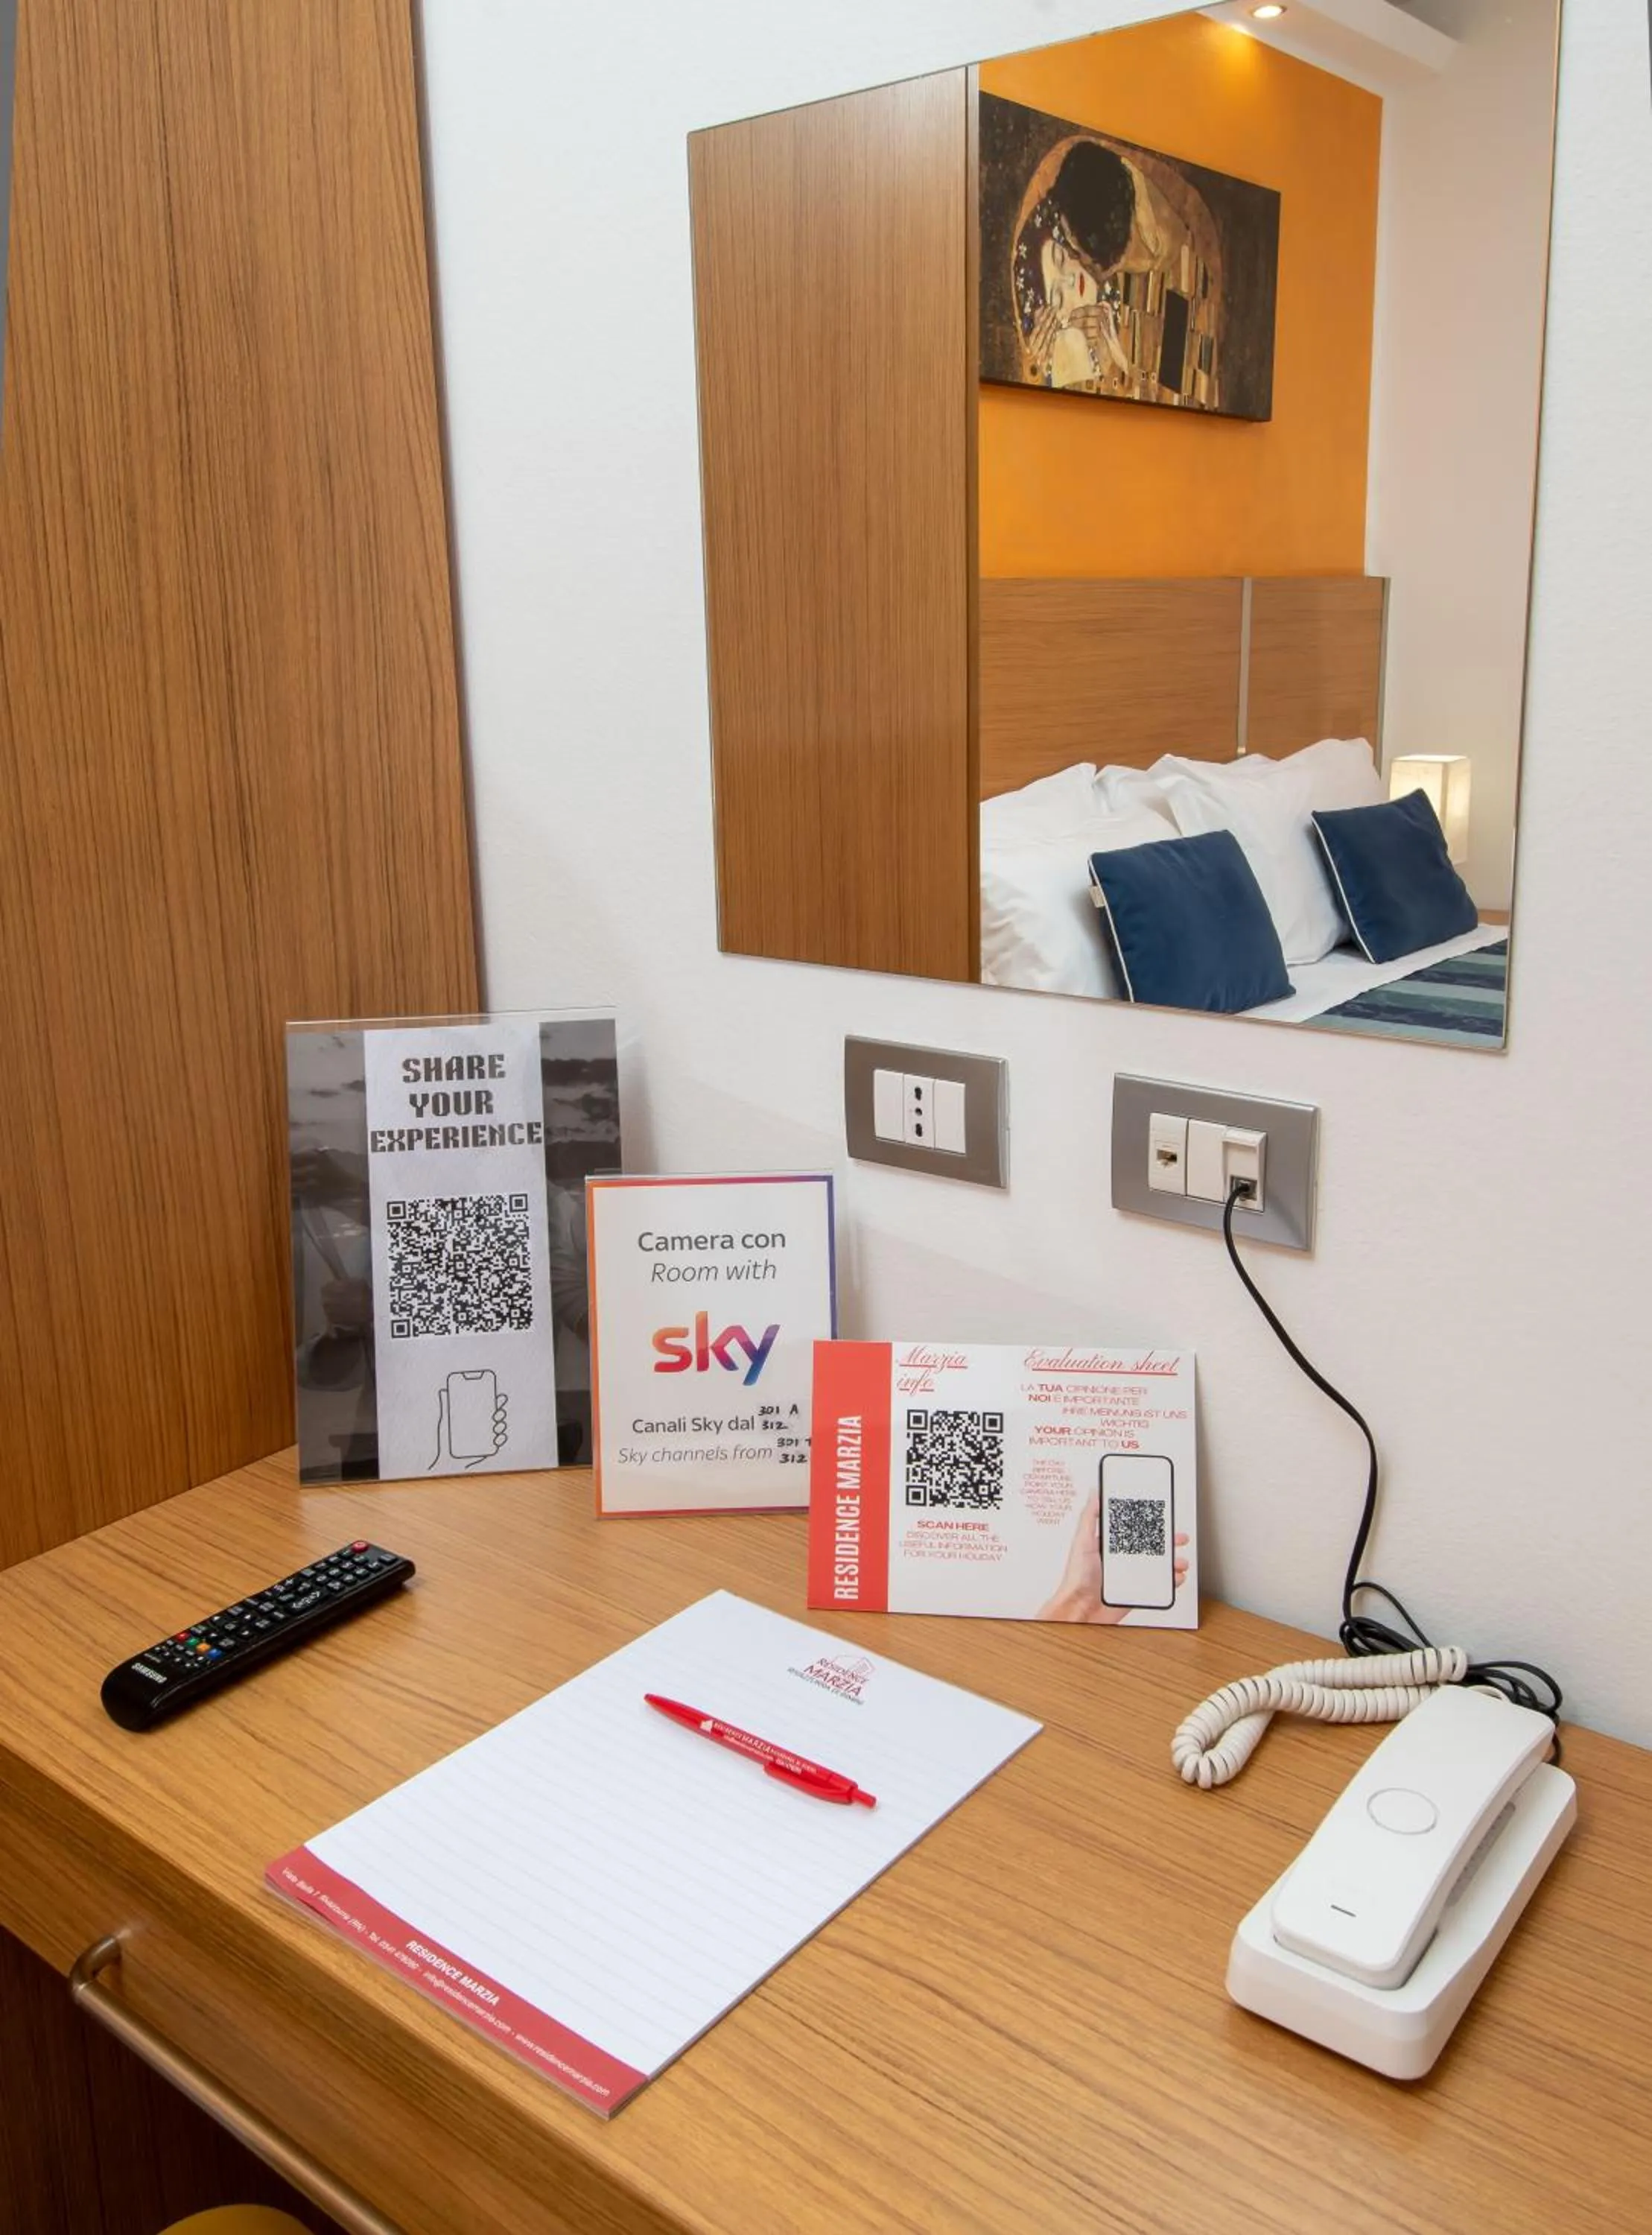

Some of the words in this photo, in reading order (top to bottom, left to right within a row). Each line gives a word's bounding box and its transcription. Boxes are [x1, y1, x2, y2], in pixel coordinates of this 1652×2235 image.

[402, 1053, 506, 1082] SHARE
[409, 1090, 494, 1118] YOUR
[370, 1121, 544, 1153] EXPERIENCE
[638, 1231, 734, 1252] Camera
[740, 1232, 787, 1249] con
[651, 1262, 719, 1283] Room
[725, 1258, 777, 1281] with
[652, 1310, 781, 1386] sky
[899, 1345, 967, 1374] Marzia
[1024, 1348, 1123, 1370] Evaluation
[1131, 1350, 1181, 1372] sheet
[1028, 1394, 1052, 1403] NOI
[1038, 1383, 1064, 1393] TUA
[758, 1405, 780, 1416] 301
[632, 1416, 687, 1434] Canali
[692, 1416, 724, 1436] Sky
[728, 1415, 754, 1431] dal
[1034, 1425, 1071, 1436] YOUR
[618, 1448, 647, 1466] Sky
[651, 1445, 729, 1463] channels
[732, 1443, 773, 1463] from
[836, 1415, 862, 1490] MARZIA
[1121, 1440, 1140, 1450] US
[779, 1453, 808, 1464] 312
[917, 1520, 953, 1529] SCAN
[956, 1522, 989, 1532] HERE
[834, 1495, 861, 1600] RESIDENCE
[131, 1661, 168, 1684] SAMSUNG
[803, 1664, 862, 1696] MARZIA
[406, 1939, 463, 1982] RESIDENCE
[460, 1975, 501, 2006] MARZIA
